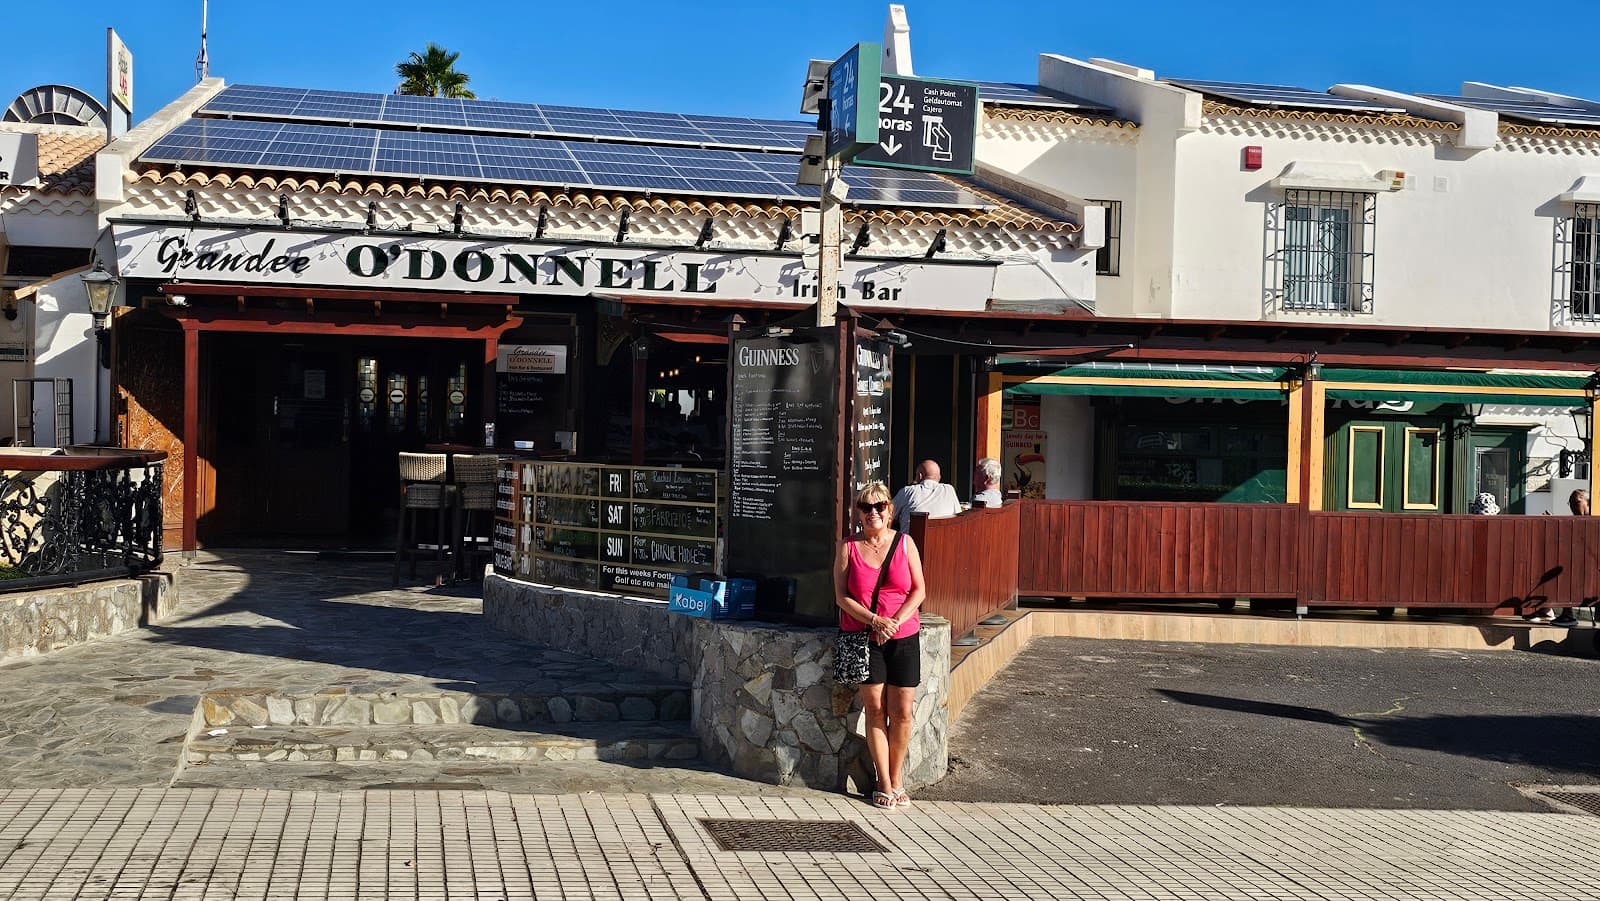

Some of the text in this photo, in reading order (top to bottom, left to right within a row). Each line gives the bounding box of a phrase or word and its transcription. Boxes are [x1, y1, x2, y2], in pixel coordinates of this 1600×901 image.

[843, 59, 855, 93] 24
[880, 82, 914, 115] 24
[924, 88, 939, 96] Cash
[923, 105, 942, 113] Cajero
[924, 97, 962, 107] Geldautomat
[157, 236, 902, 300] Grandee O'DONNELL Irih Bar
[739, 346, 800, 367] GUINNESS
[609, 473, 622, 493] FRI
[607, 505, 623, 524] SAT
[607, 537, 623, 557] SUN
[616, 567, 628, 575] this
[630, 568, 652, 577] weeks
[675, 593, 707, 611] Kabel
